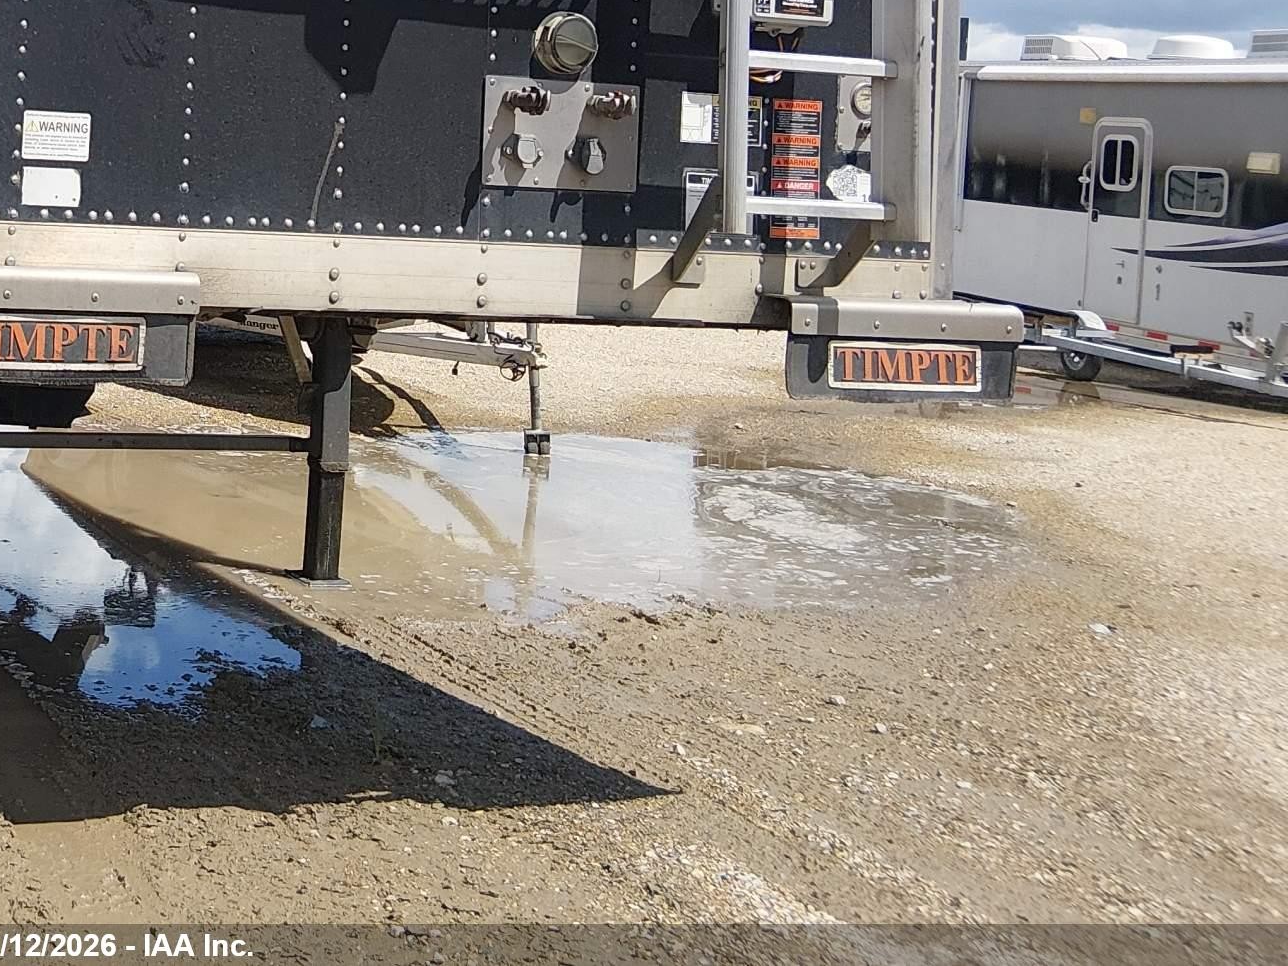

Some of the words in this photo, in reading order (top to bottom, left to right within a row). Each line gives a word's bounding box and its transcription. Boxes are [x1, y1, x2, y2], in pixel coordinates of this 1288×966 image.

[784, 101, 819, 111] WARNING
[38, 120, 89, 134] WARNING
[783, 135, 818, 145] WARNING
[783, 157, 817, 167] WARNING
[784, 181, 814, 191] DANGER
[836, 347, 975, 384] TIMPTE
